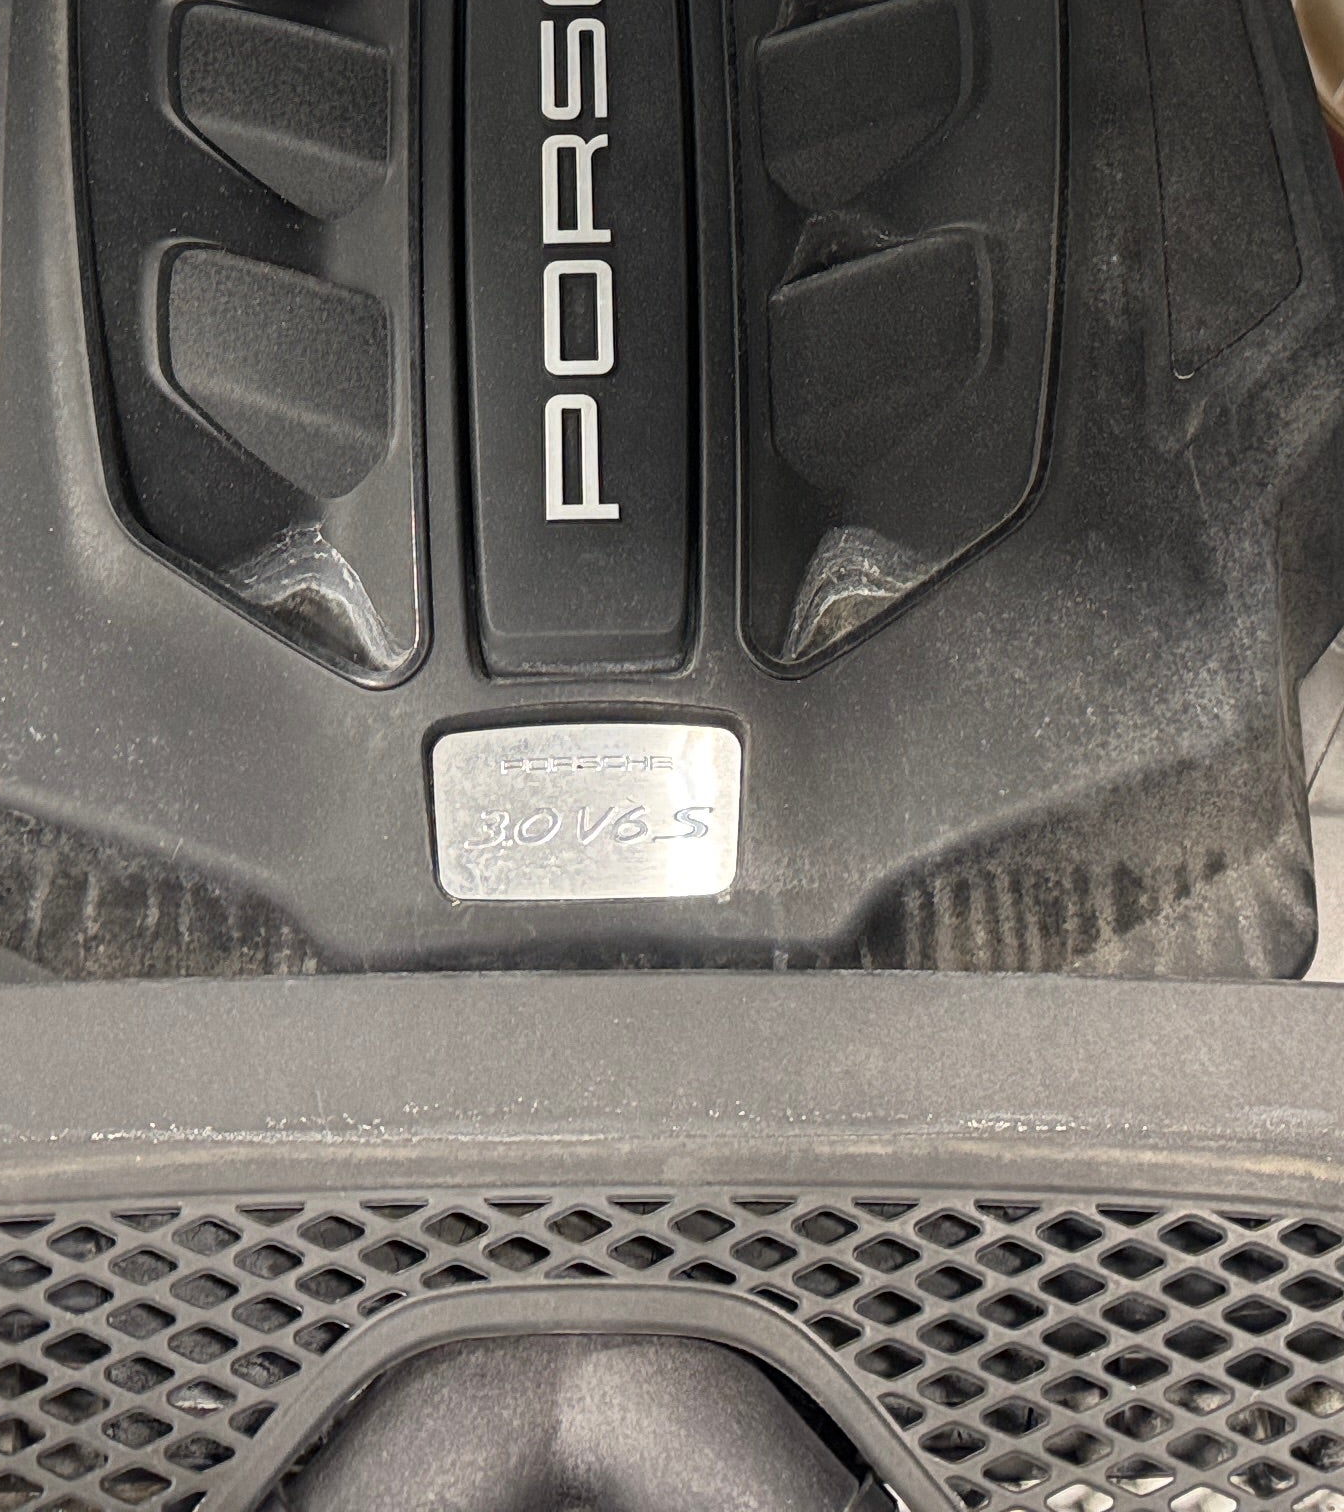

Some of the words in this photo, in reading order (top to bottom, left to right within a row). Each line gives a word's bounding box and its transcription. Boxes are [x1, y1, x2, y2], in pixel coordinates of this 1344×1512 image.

[500, 755, 674, 775] PORSCHE
[463, 806, 562, 851] 3.0
[576, 805, 652, 846] V6
